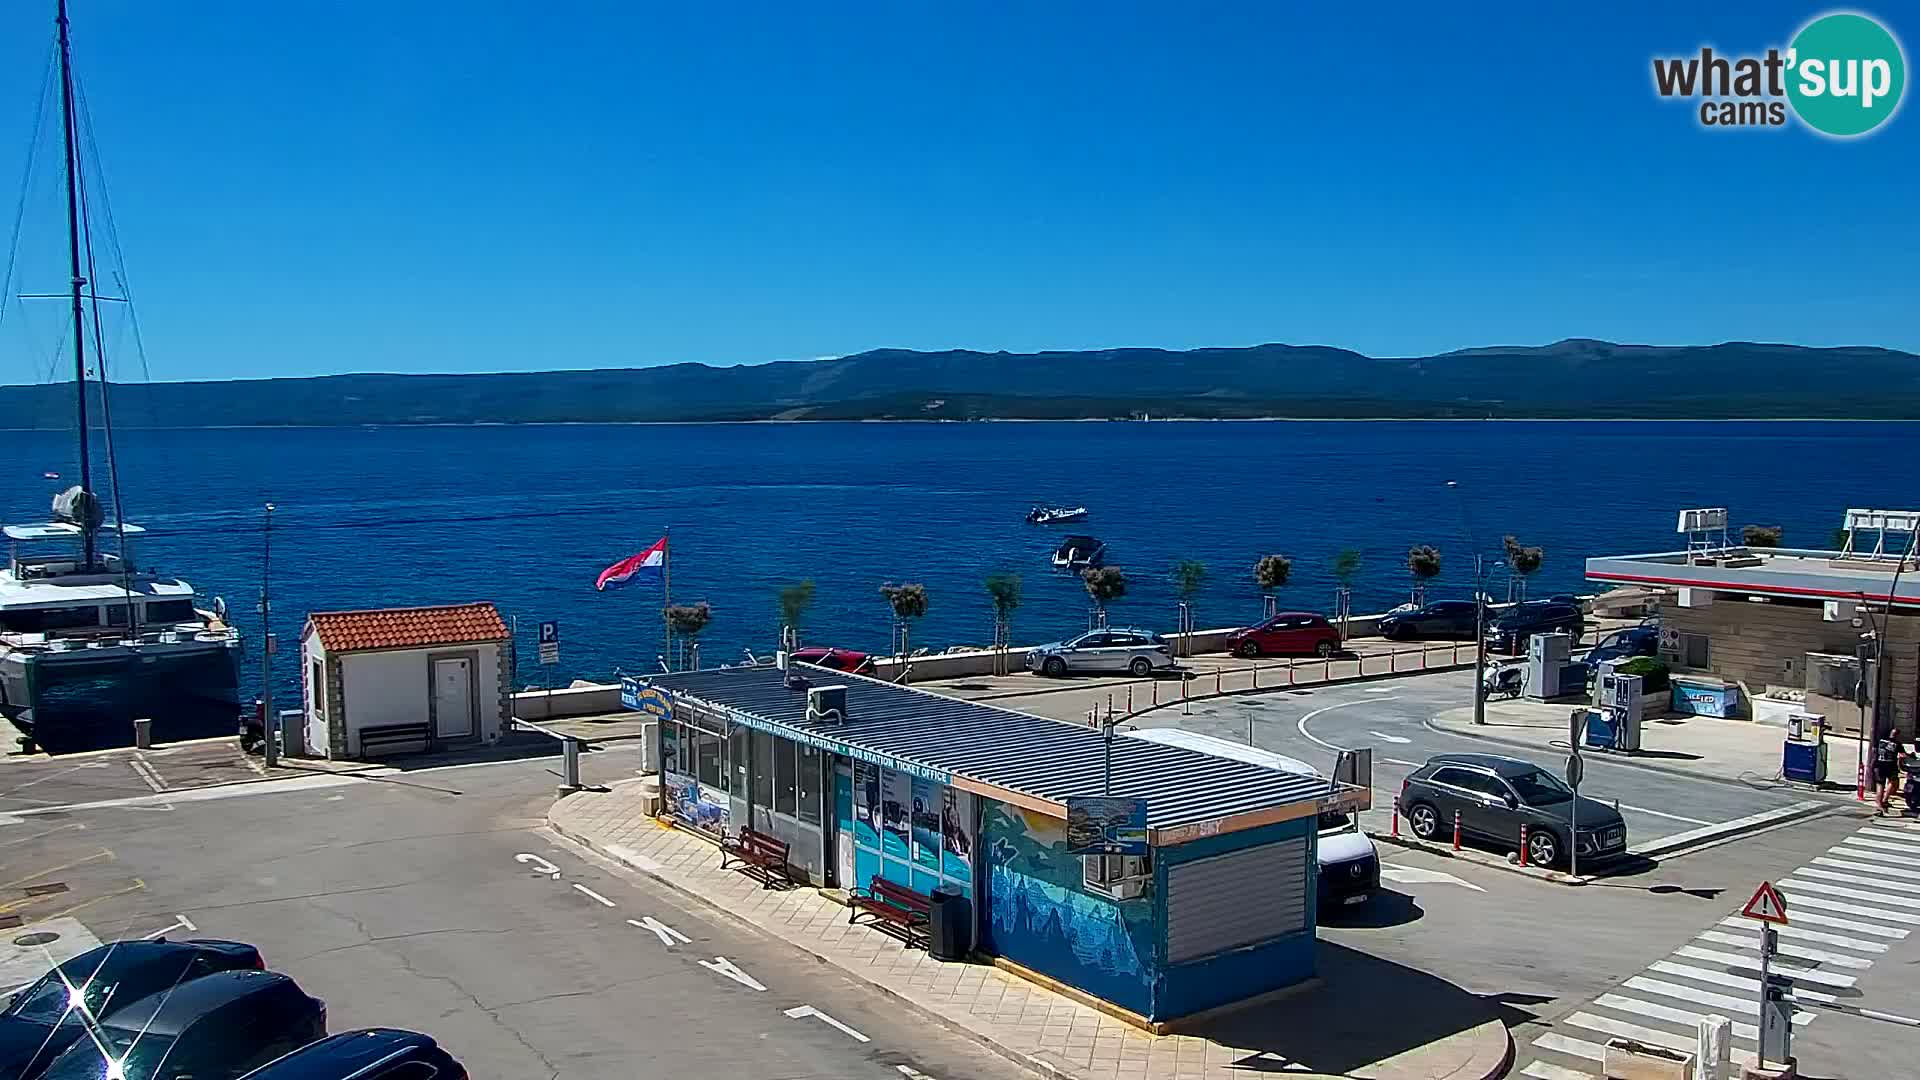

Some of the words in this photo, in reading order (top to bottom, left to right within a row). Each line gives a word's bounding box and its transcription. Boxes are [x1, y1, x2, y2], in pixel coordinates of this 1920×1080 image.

[543, 623, 554, 641] P
[810, 736, 839, 752] POSTAJA
[848, 746, 862, 759] BUS
[863, 752, 894, 768] STATION
[896, 760, 920, 776] TICKET
[921, 769, 947, 783] OFFICE
